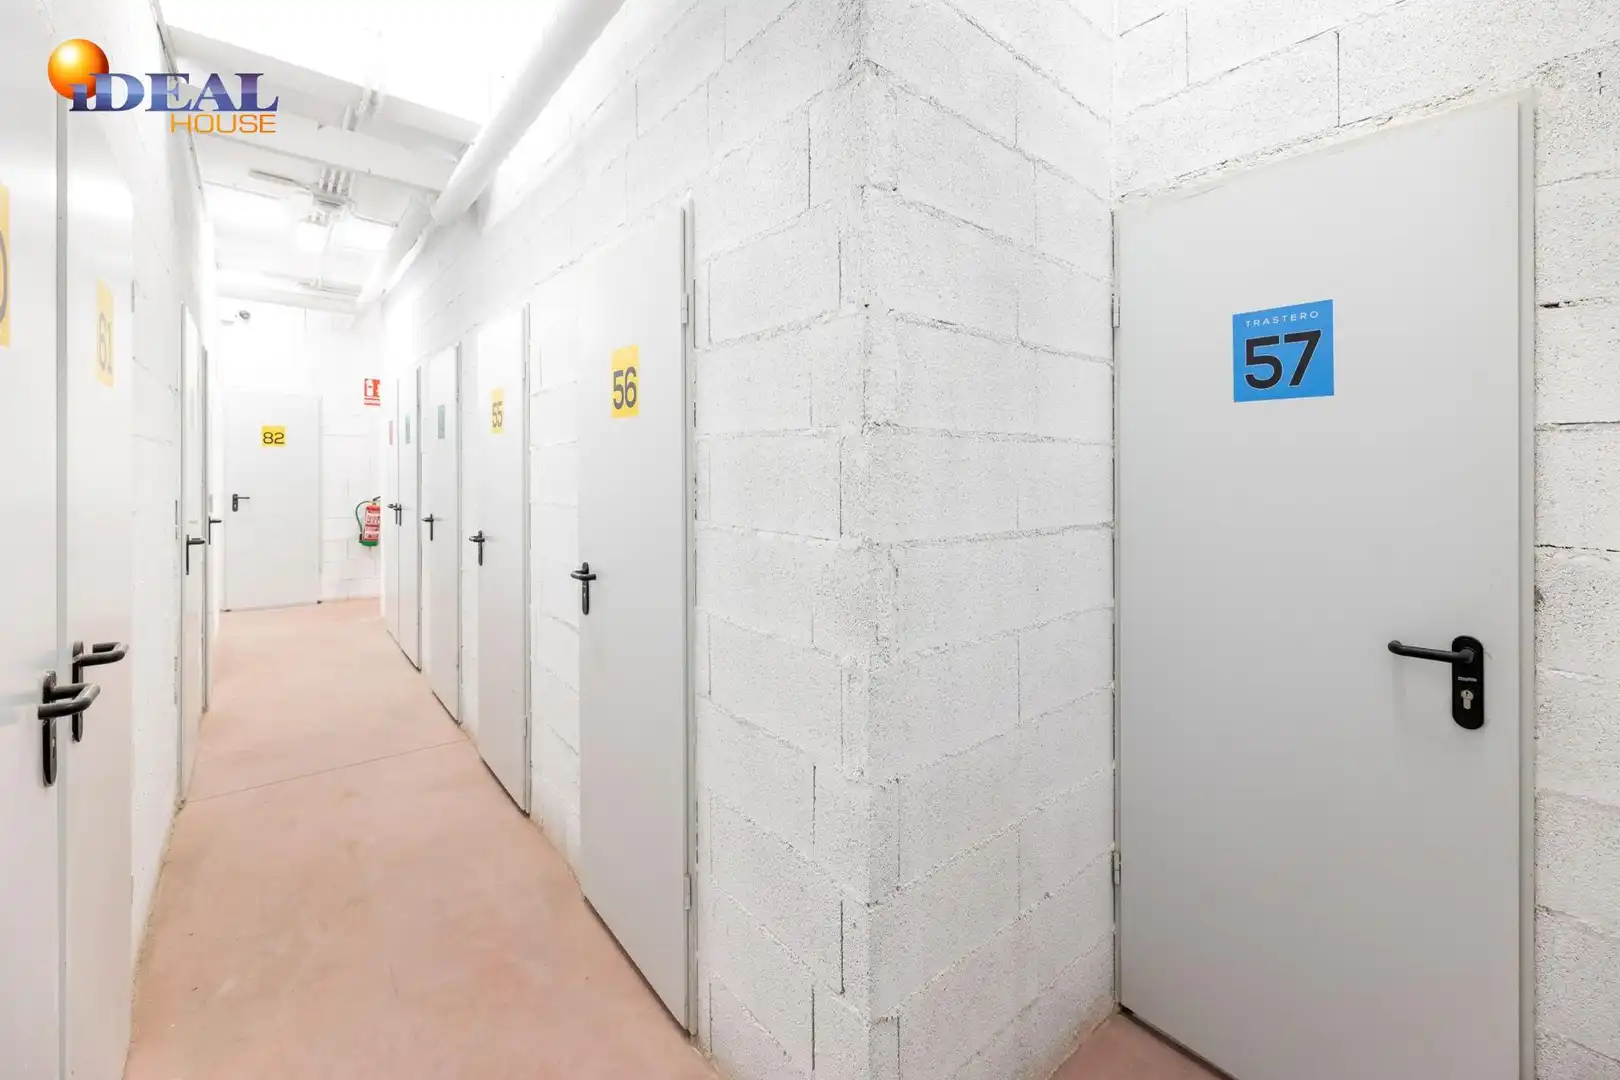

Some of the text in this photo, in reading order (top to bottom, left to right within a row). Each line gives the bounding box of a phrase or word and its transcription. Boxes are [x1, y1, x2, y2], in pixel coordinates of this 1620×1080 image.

[1245, 311, 1319, 328] TRASTERO
[1245, 329, 1322, 390] 57
[612, 366, 637, 410] 56
[492, 400, 503, 428] 55
[263, 432, 285, 445] 82
